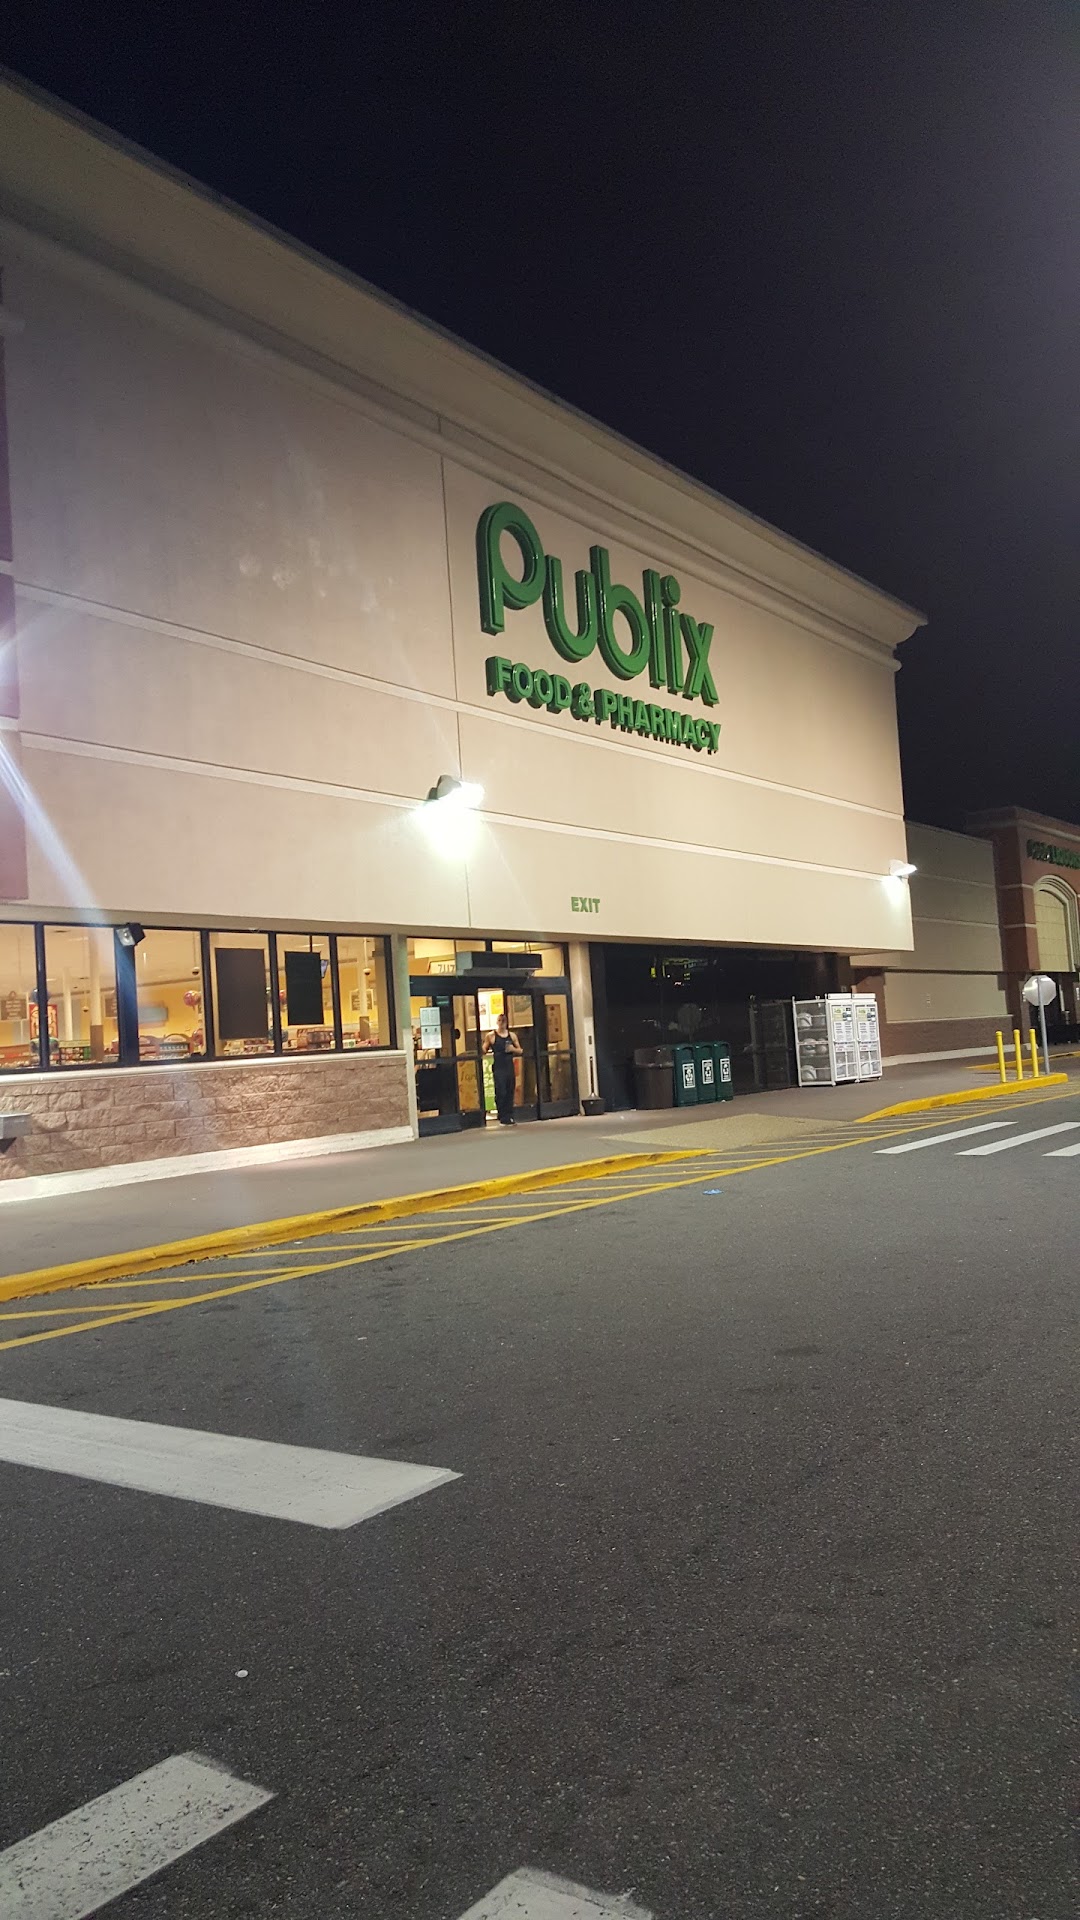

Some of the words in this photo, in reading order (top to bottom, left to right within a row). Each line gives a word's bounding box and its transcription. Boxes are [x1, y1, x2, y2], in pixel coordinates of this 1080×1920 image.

[476, 501, 719, 707] Publix
[485, 656, 572, 714] FOOD
[570, 682, 597, 722] &
[593, 688, 722, 755] PHARMACY
[571, 896, 600, 913] EXIT
